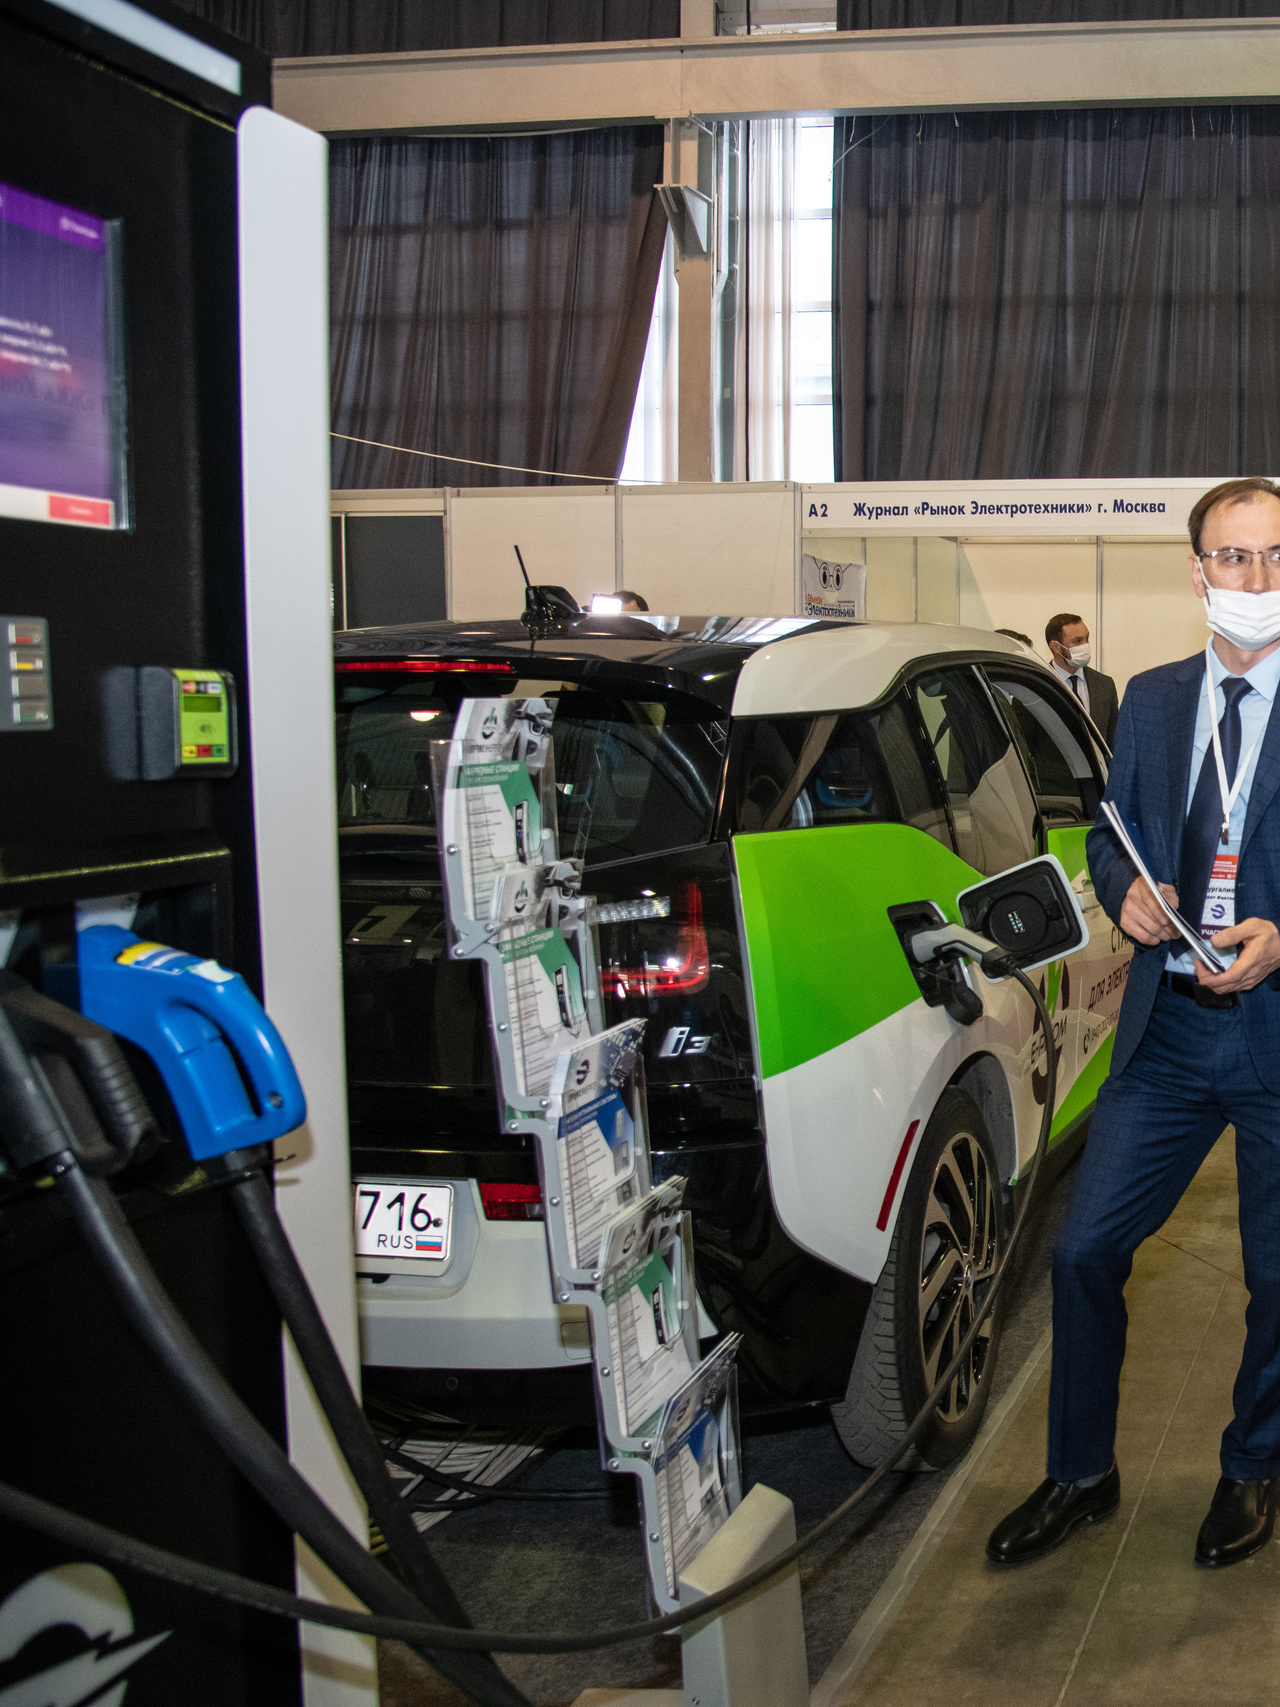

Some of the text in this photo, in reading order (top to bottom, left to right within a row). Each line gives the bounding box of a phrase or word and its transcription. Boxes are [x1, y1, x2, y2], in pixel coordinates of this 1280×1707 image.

[852, 499, 1166, 520] Журнал «Рынок Электротехники» г. Москва
[359, 1190, 433, 1232] 716
[377, 1233, 414, 1250] RUS
